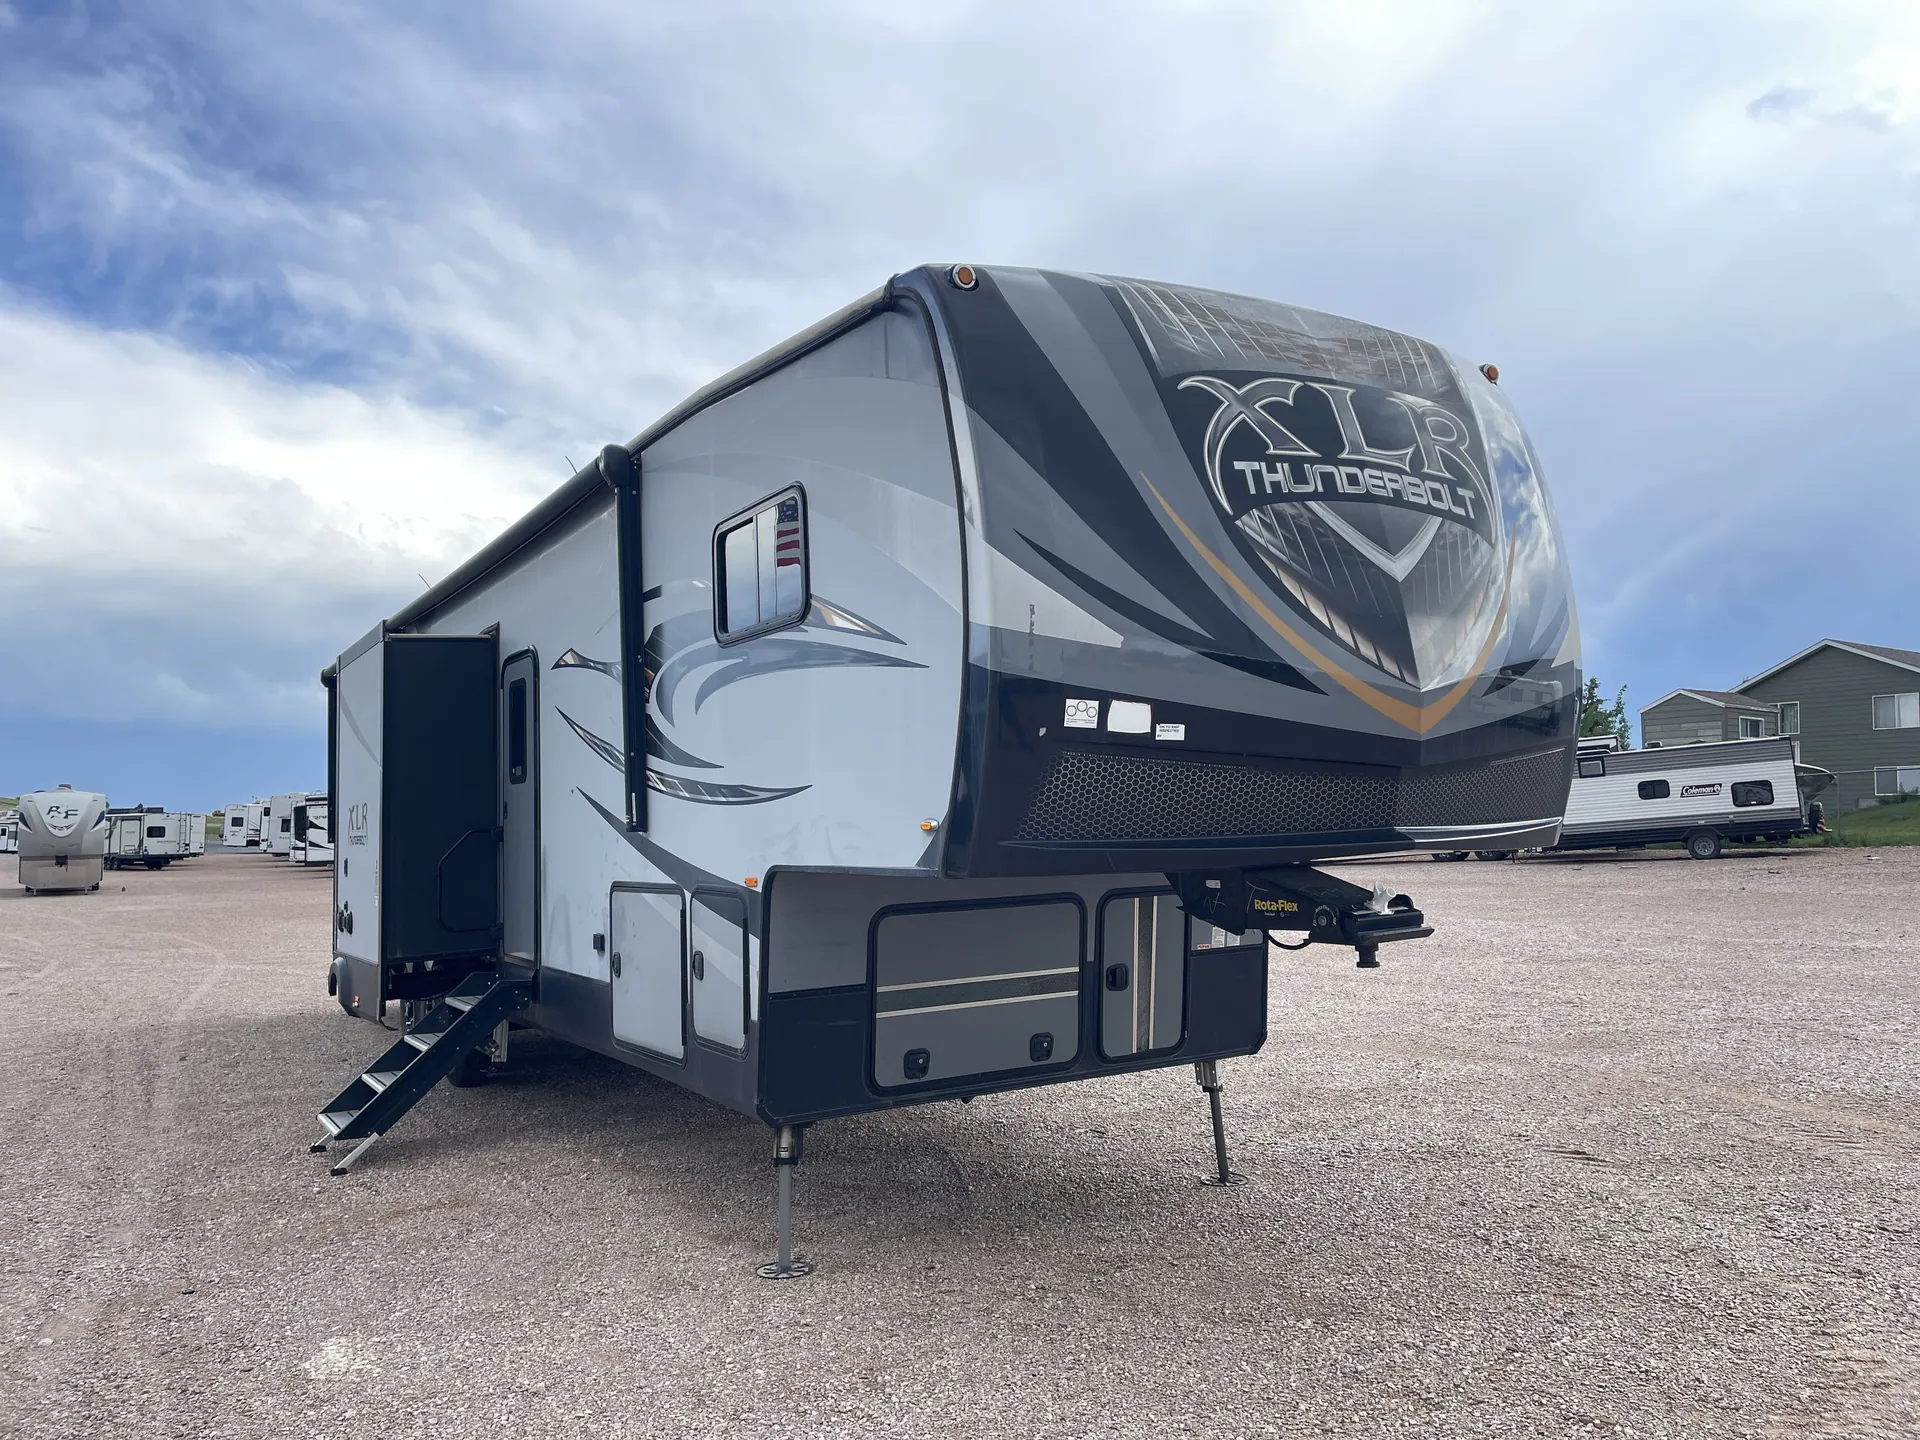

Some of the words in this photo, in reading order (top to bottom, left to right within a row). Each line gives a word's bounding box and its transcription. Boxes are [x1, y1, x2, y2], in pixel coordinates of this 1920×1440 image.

[1177, 375, 1497, 543] XLR
[1233, 461, 1476, 520] THUNDERBOLT
[1682, 785, 1714, 796] Coleman
[348, 803, 368, 836] XLR
